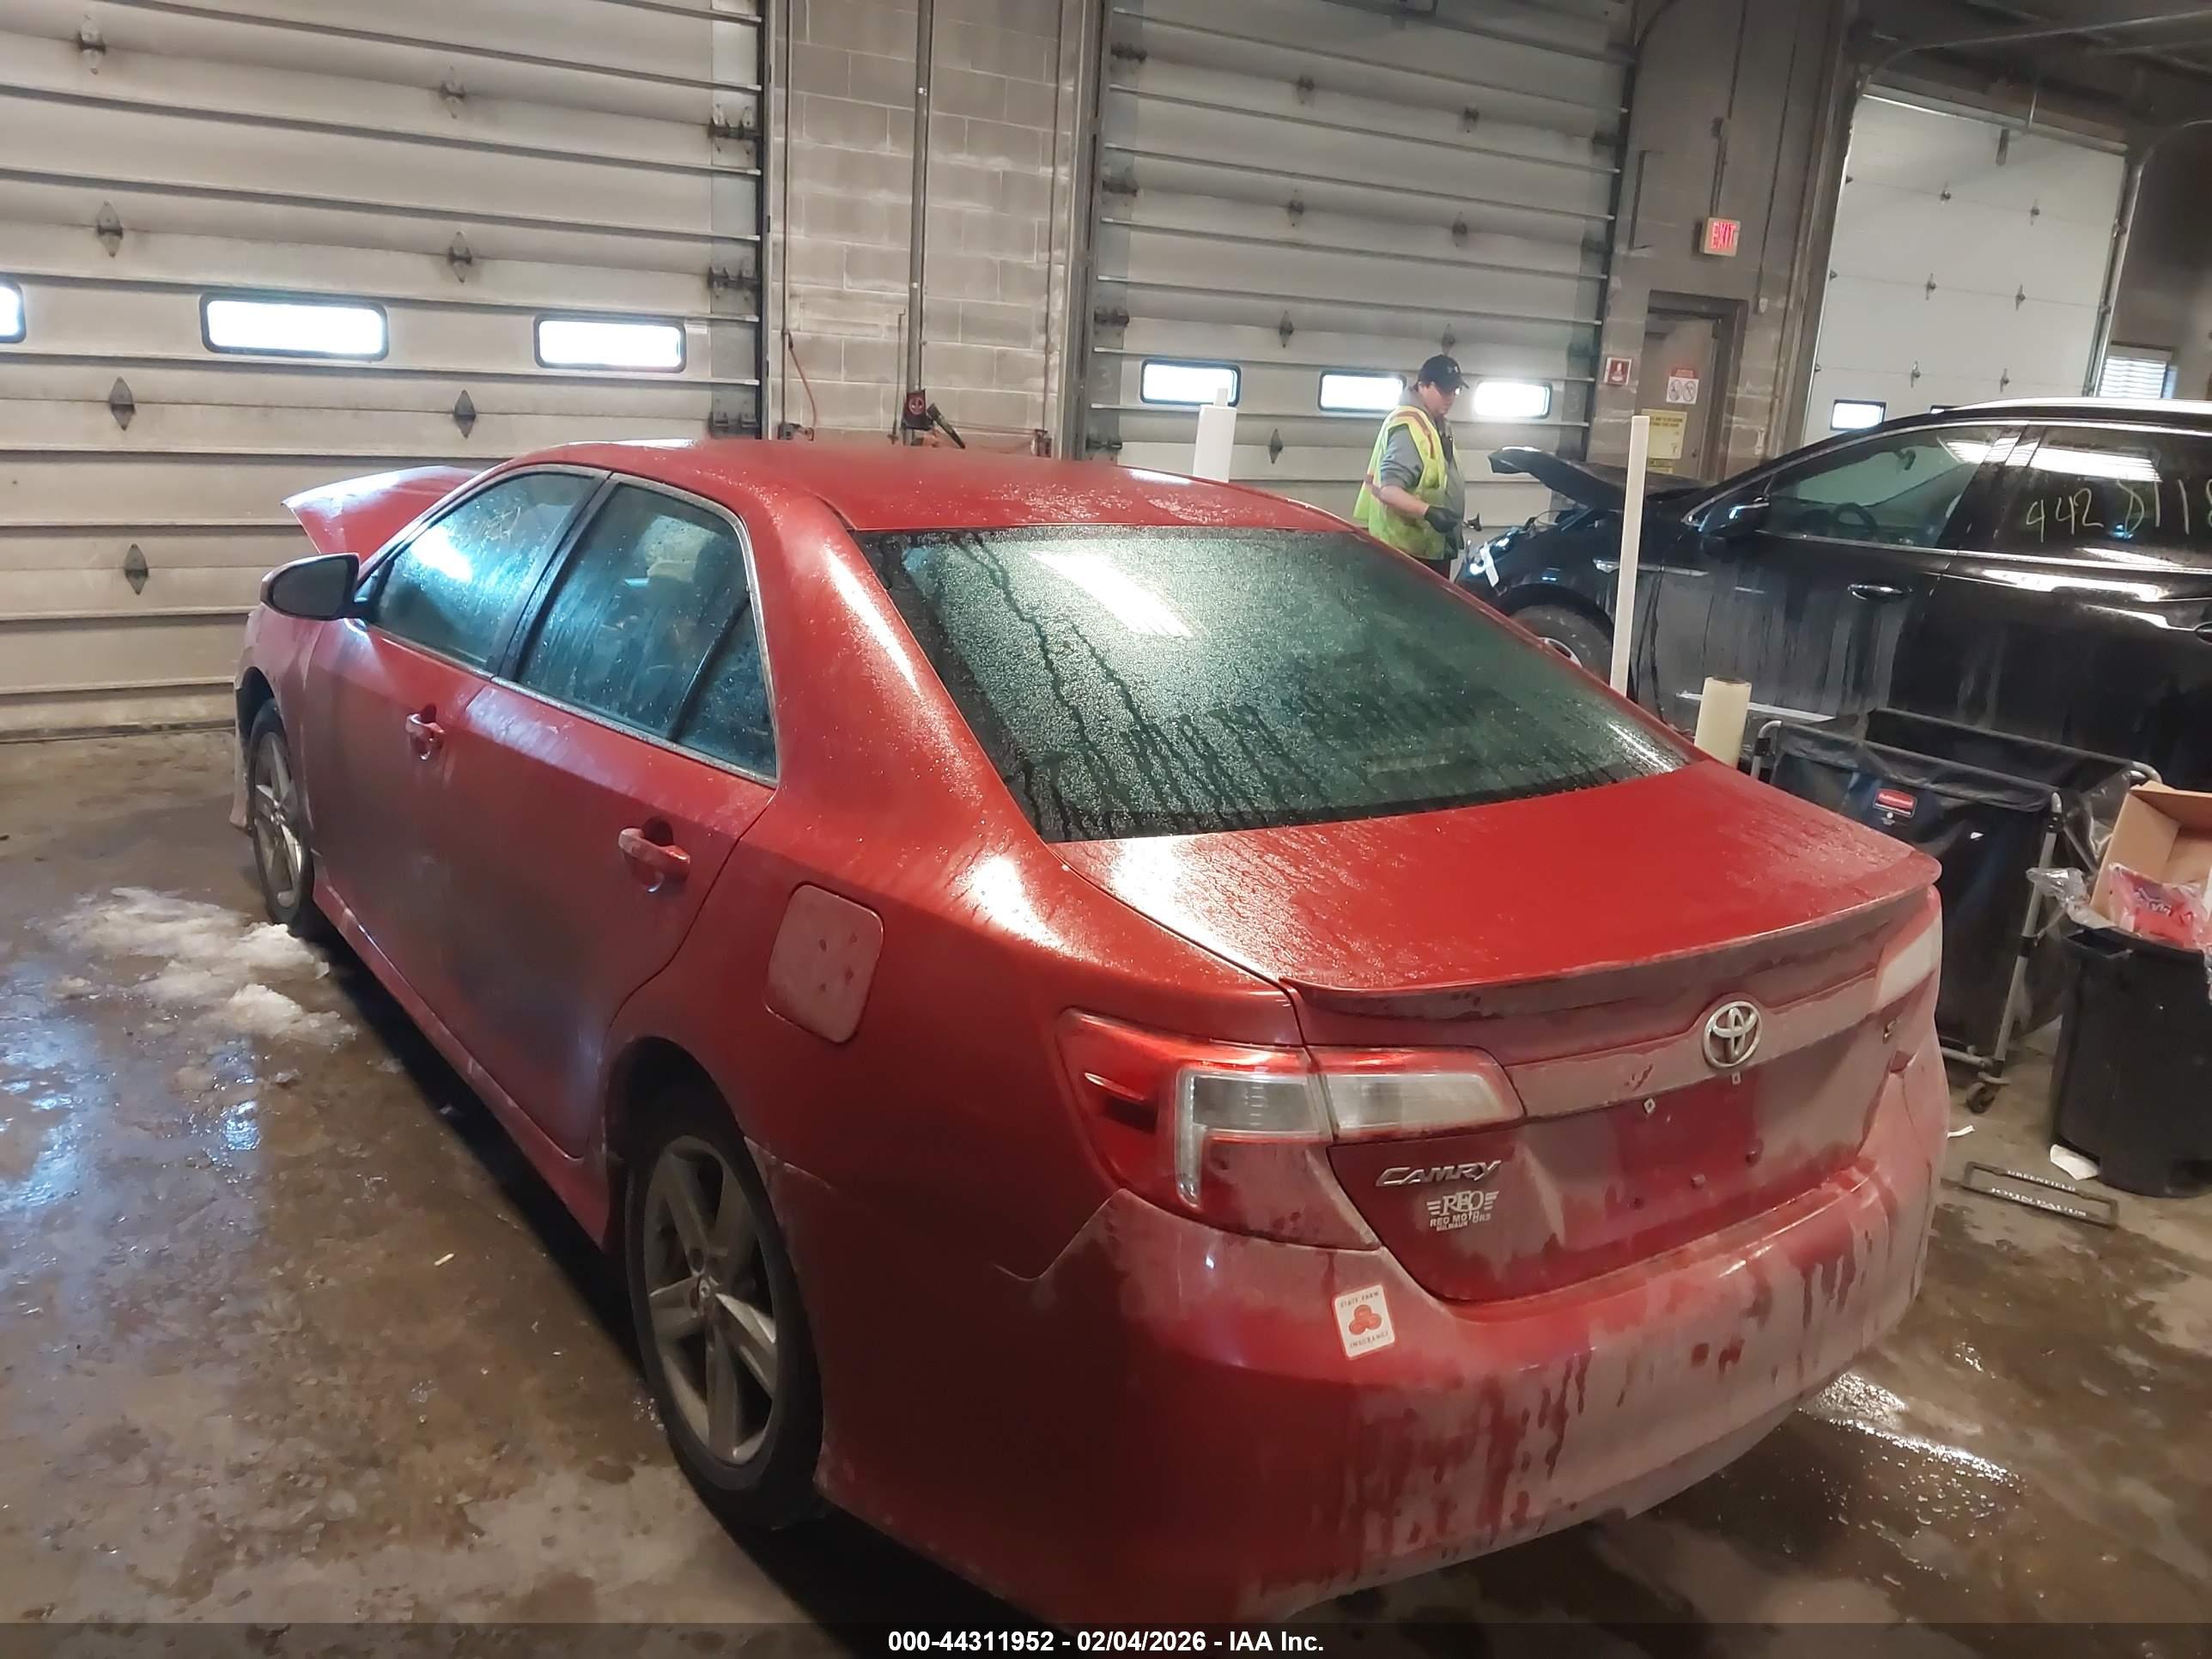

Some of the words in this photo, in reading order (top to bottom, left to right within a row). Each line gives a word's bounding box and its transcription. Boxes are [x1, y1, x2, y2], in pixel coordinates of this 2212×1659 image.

[1711, 222, 1737, 248] EXIT
[1376, 1160, 1502, 1187] CAMRY
[1340, 1297, 1358, 1308] STATE
[1361, 1291, 1379, 1301] FARM
[1349, 1330, 1389, 1348] INSURANCE
